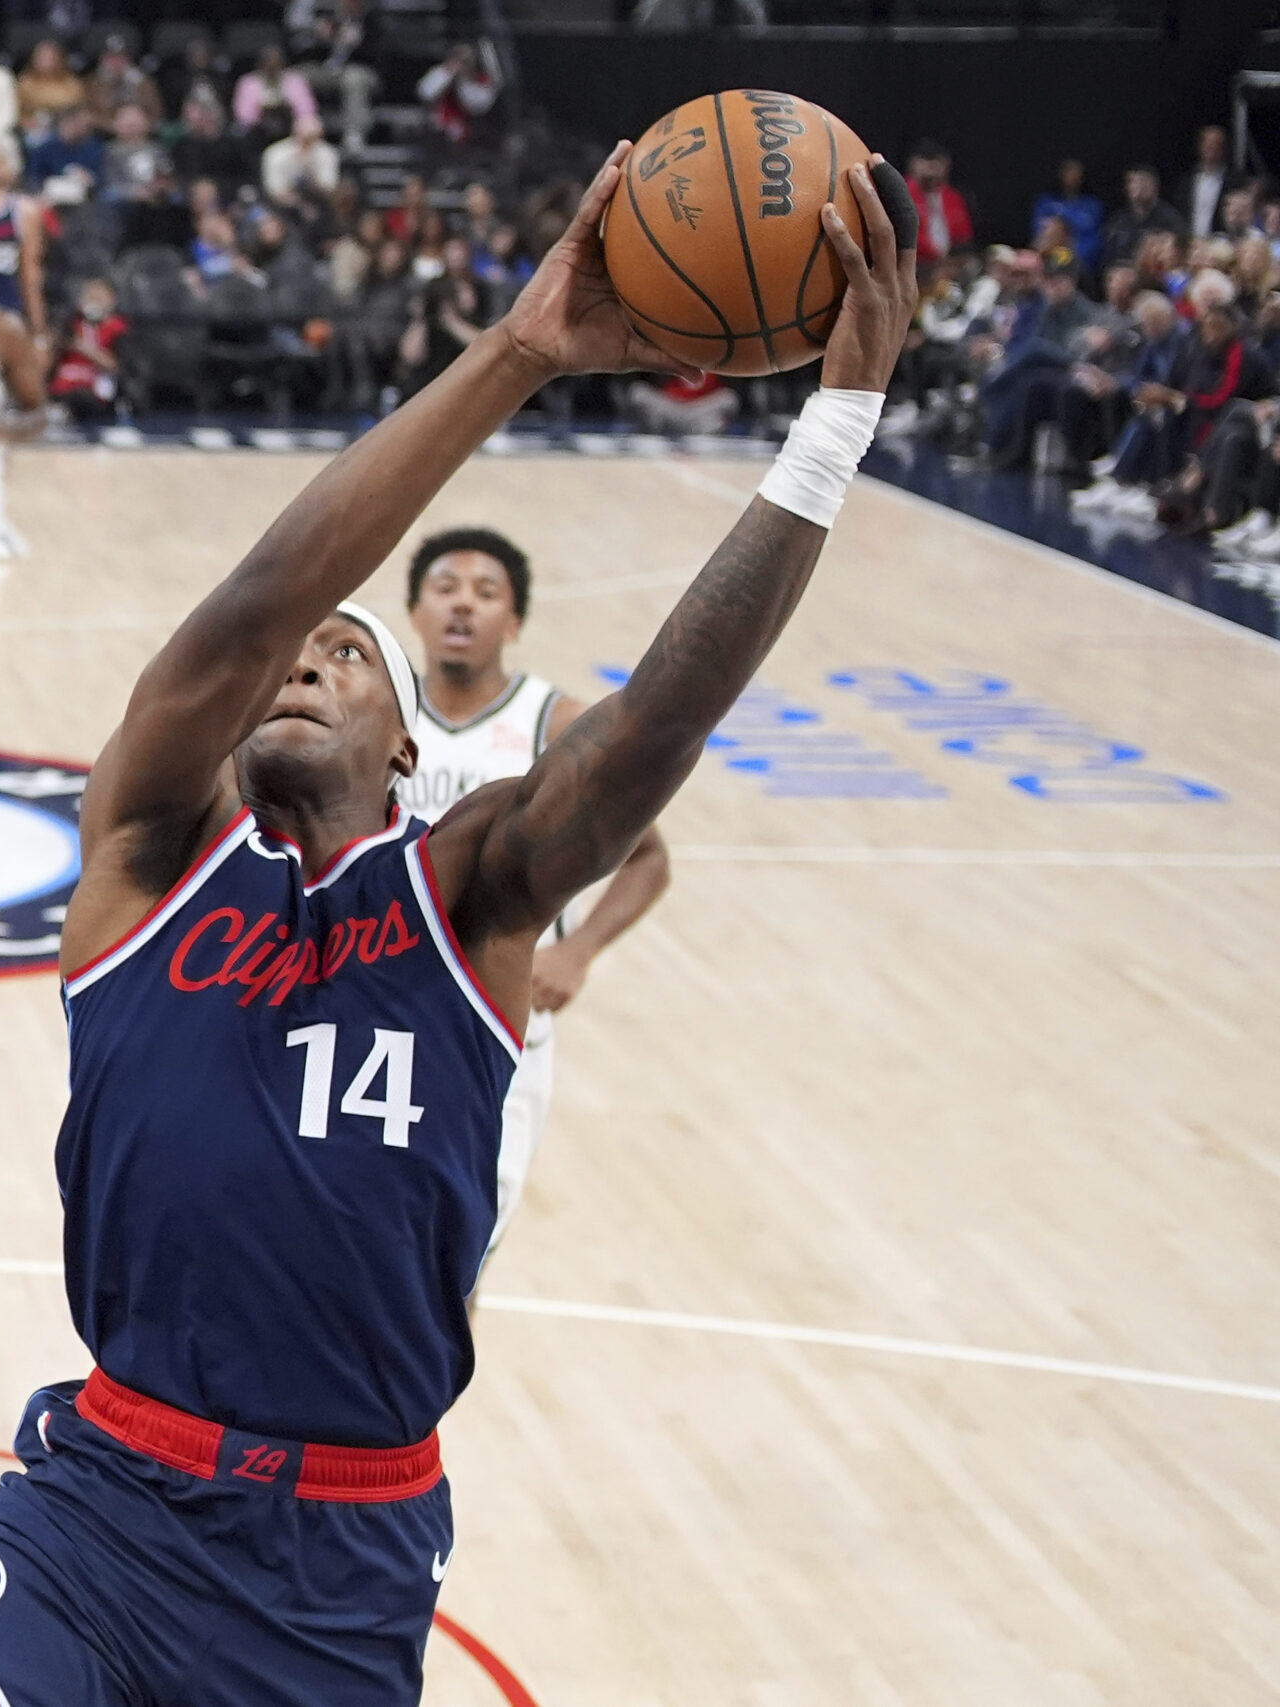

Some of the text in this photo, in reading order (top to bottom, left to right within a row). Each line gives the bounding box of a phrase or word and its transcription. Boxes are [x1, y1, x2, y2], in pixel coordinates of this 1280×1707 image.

[169, 899, 420, 1008] Clippers
[285, 1022, 425, 1149] 14
[231, 1443, 288, 1483] LA
